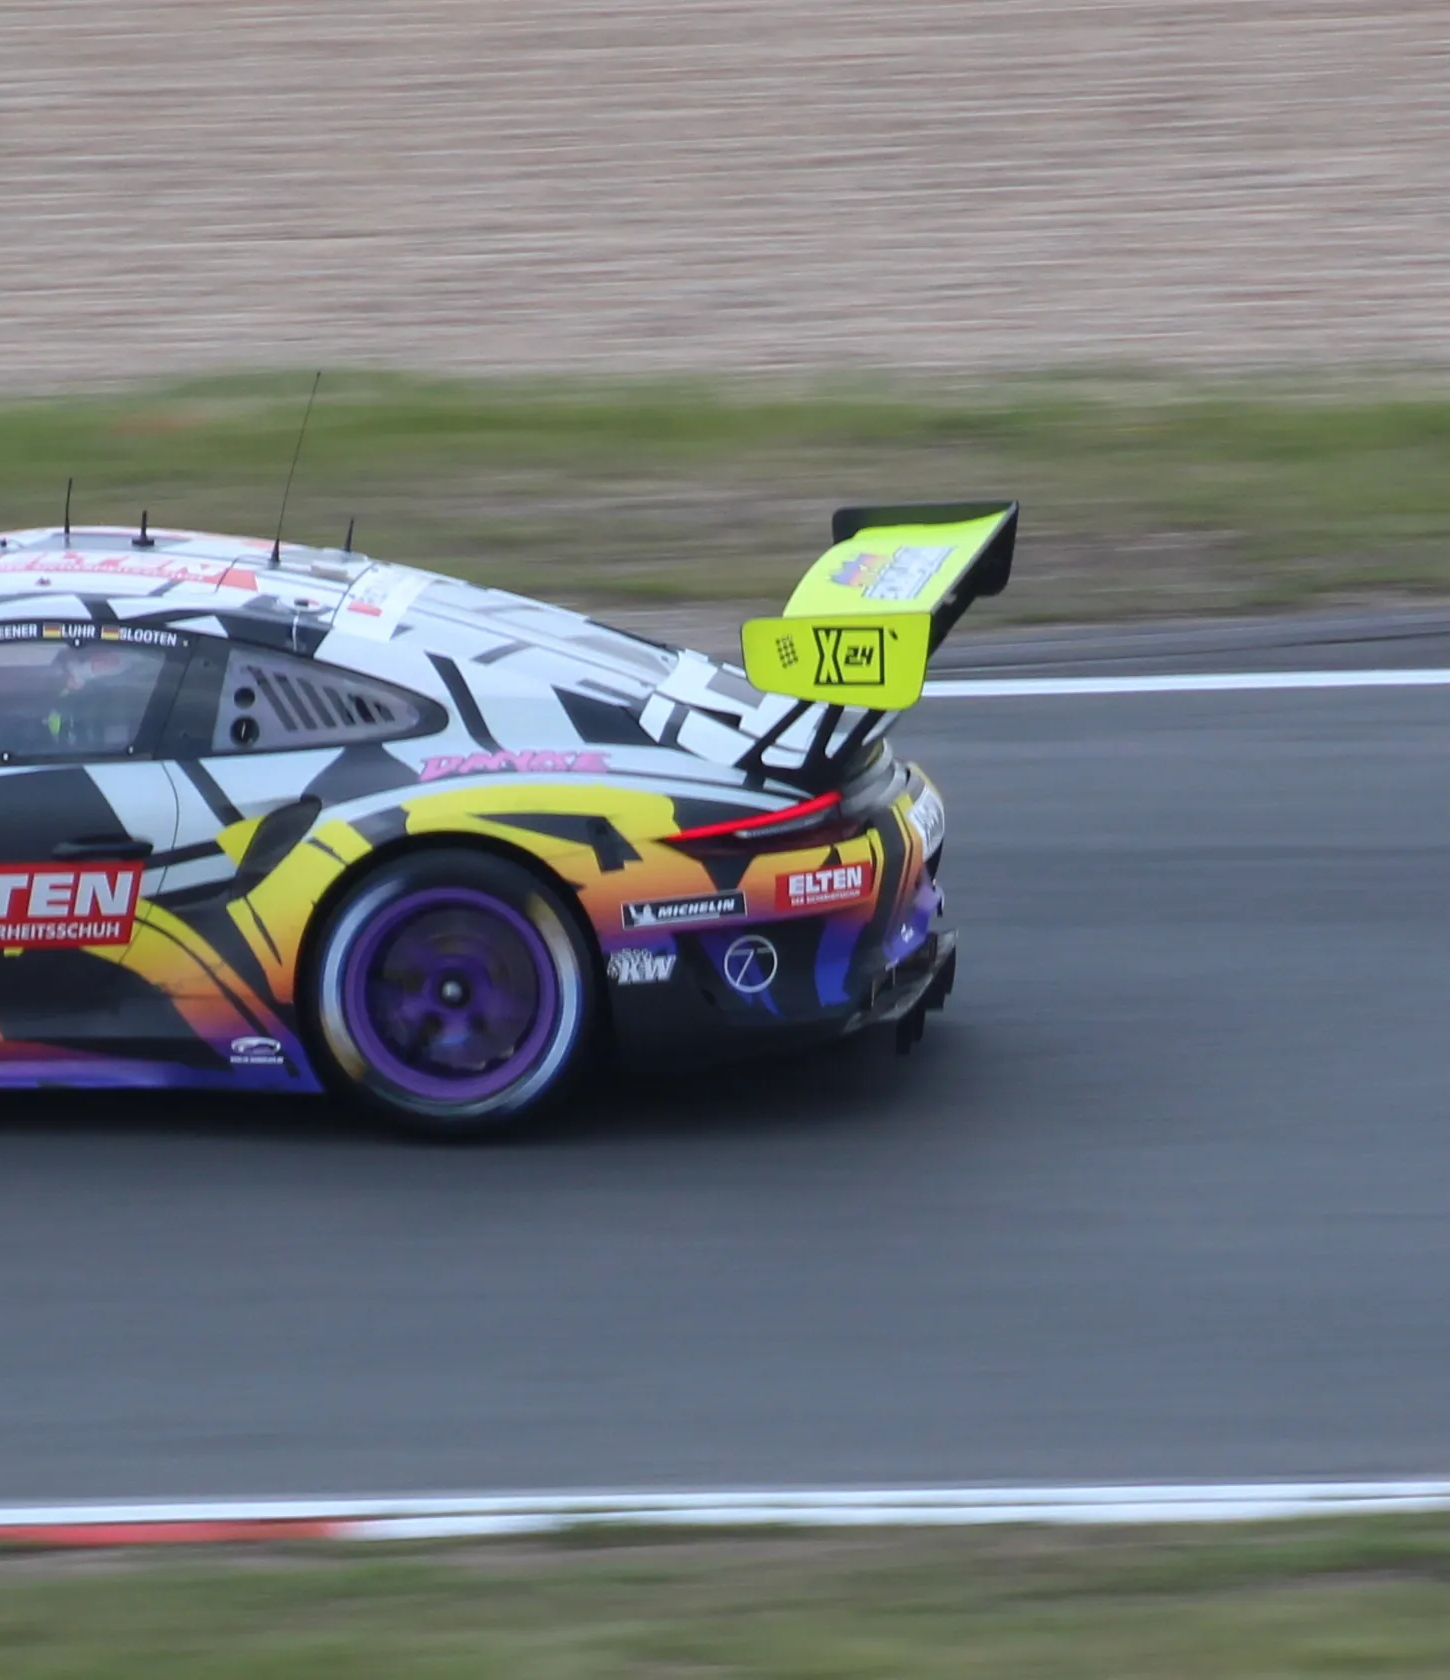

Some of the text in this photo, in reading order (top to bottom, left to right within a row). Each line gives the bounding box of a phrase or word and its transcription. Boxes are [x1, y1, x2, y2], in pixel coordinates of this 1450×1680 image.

[61, 624, 96, 639] LUHR
[118, 627, 178, 646] SLOOTEN
[788, 865, 863, 897] ELTEN
[657, 898, 736, 918] MICHELIN
